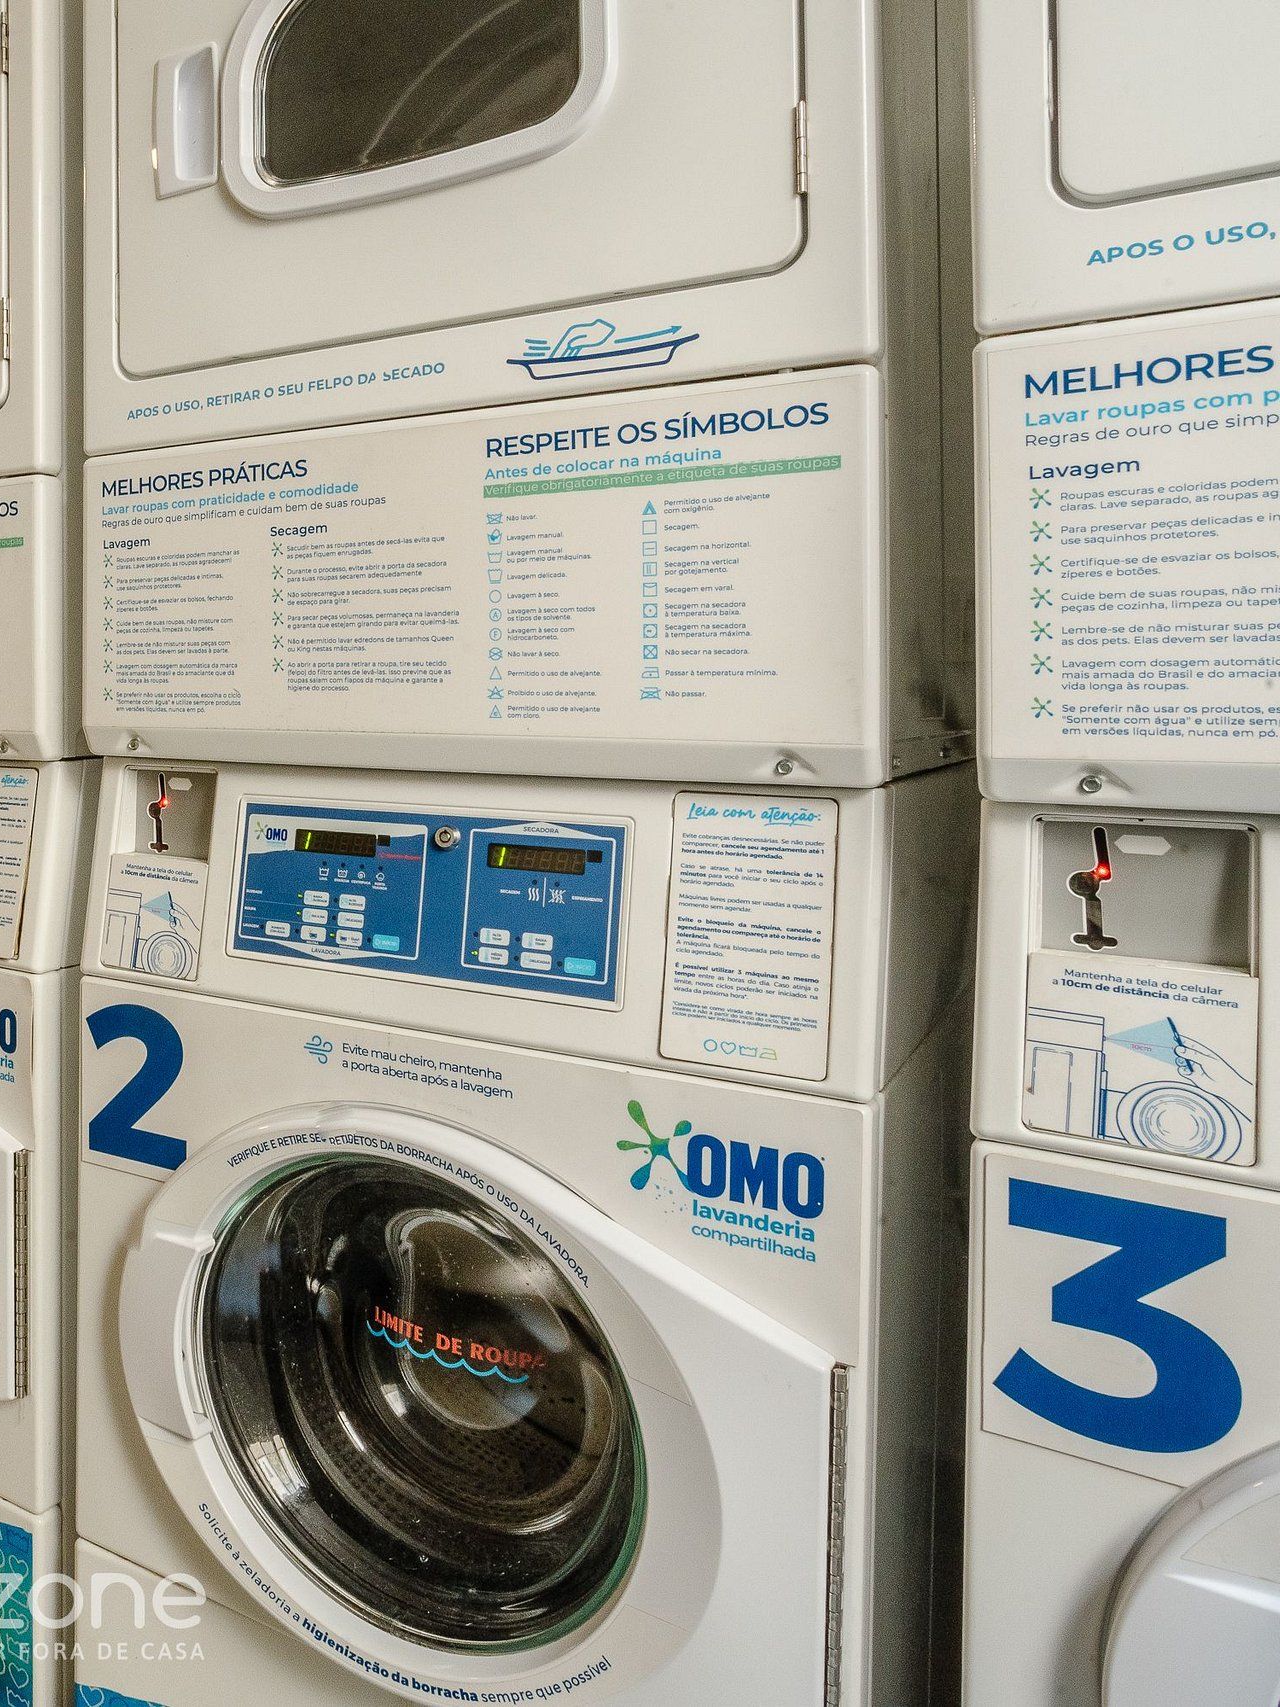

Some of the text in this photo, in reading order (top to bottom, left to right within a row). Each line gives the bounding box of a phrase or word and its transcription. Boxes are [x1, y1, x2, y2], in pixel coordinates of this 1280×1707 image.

[1086, 221, 1276, 265] APOS O USO,
[1024, 345, 1274, 398] MELHORES
[126, 405, 159, 420] APOS
[162, 404, 171, 414] O
[174, 399, 203, 412] USO,
[206, 389, 260, 407] RETIRAR
[263, 386, 274, 398] O
[277, 382, 303, 396] SEU
[308, 375, 353, 391] FELPO
[357, 372, 376, 385] DA
[1025, 392, 1252, 426] Lavar roupas com
[486, 402, 828, 457] RESPEITE OS SÍMBOLOS
[102, 459, 307, 497] MELHORES PRÁTICAS
[1029, 460, 1139, 479] Lavagem
[101, 481, 358, 515] Lavar roupas com praticidade e comodidade
[103, 538, 150, 550] Lavagem
[270, 524, 327, 537] Secagem
[1060, 529, 1218, 545] use saquinhos protetores.
[1060, 681, 1189, 692] vida longa às roupas.
[523, 826, 560, 834] SECADORA
[686, 802, 718, 822] Leia
[722, 808, 756, 819] com
[265, 828, 288, 841] OMO
[310, 947, 342, 956] LAVADORA
[1060, 978, 1092, 989] 10cm
[1094, 982, 1110, 991] de
[1112, 985, 1169, 999] distância
[1172, 992, 1188, 1002] da
[1191, 995, 1238, 1008] câmera
[1064, 968, 1122, 983] Mantenha
[1135, 977, 1158, 987] tela
[1160, 980, 1177, 990] do
[1180, 984, 1223, 995] celular
[341, 1059, 512, 1099] a porta aberta após a lavagem
[342, 1042, 502, 1080] Evite mau cheiro, mantenha
[86, 1003, 187, 1172] 2
[687, 1133, 825, 1220] OMO
[692, 1198, 816, 1243] lavanderia
[691, 1224, 817, 1263] compartilhada
[374, 1305, 424, 1343] LIMITE
[436, 1332, 463, 1356] DE
[992, 1177, 1242, 1454] 3
